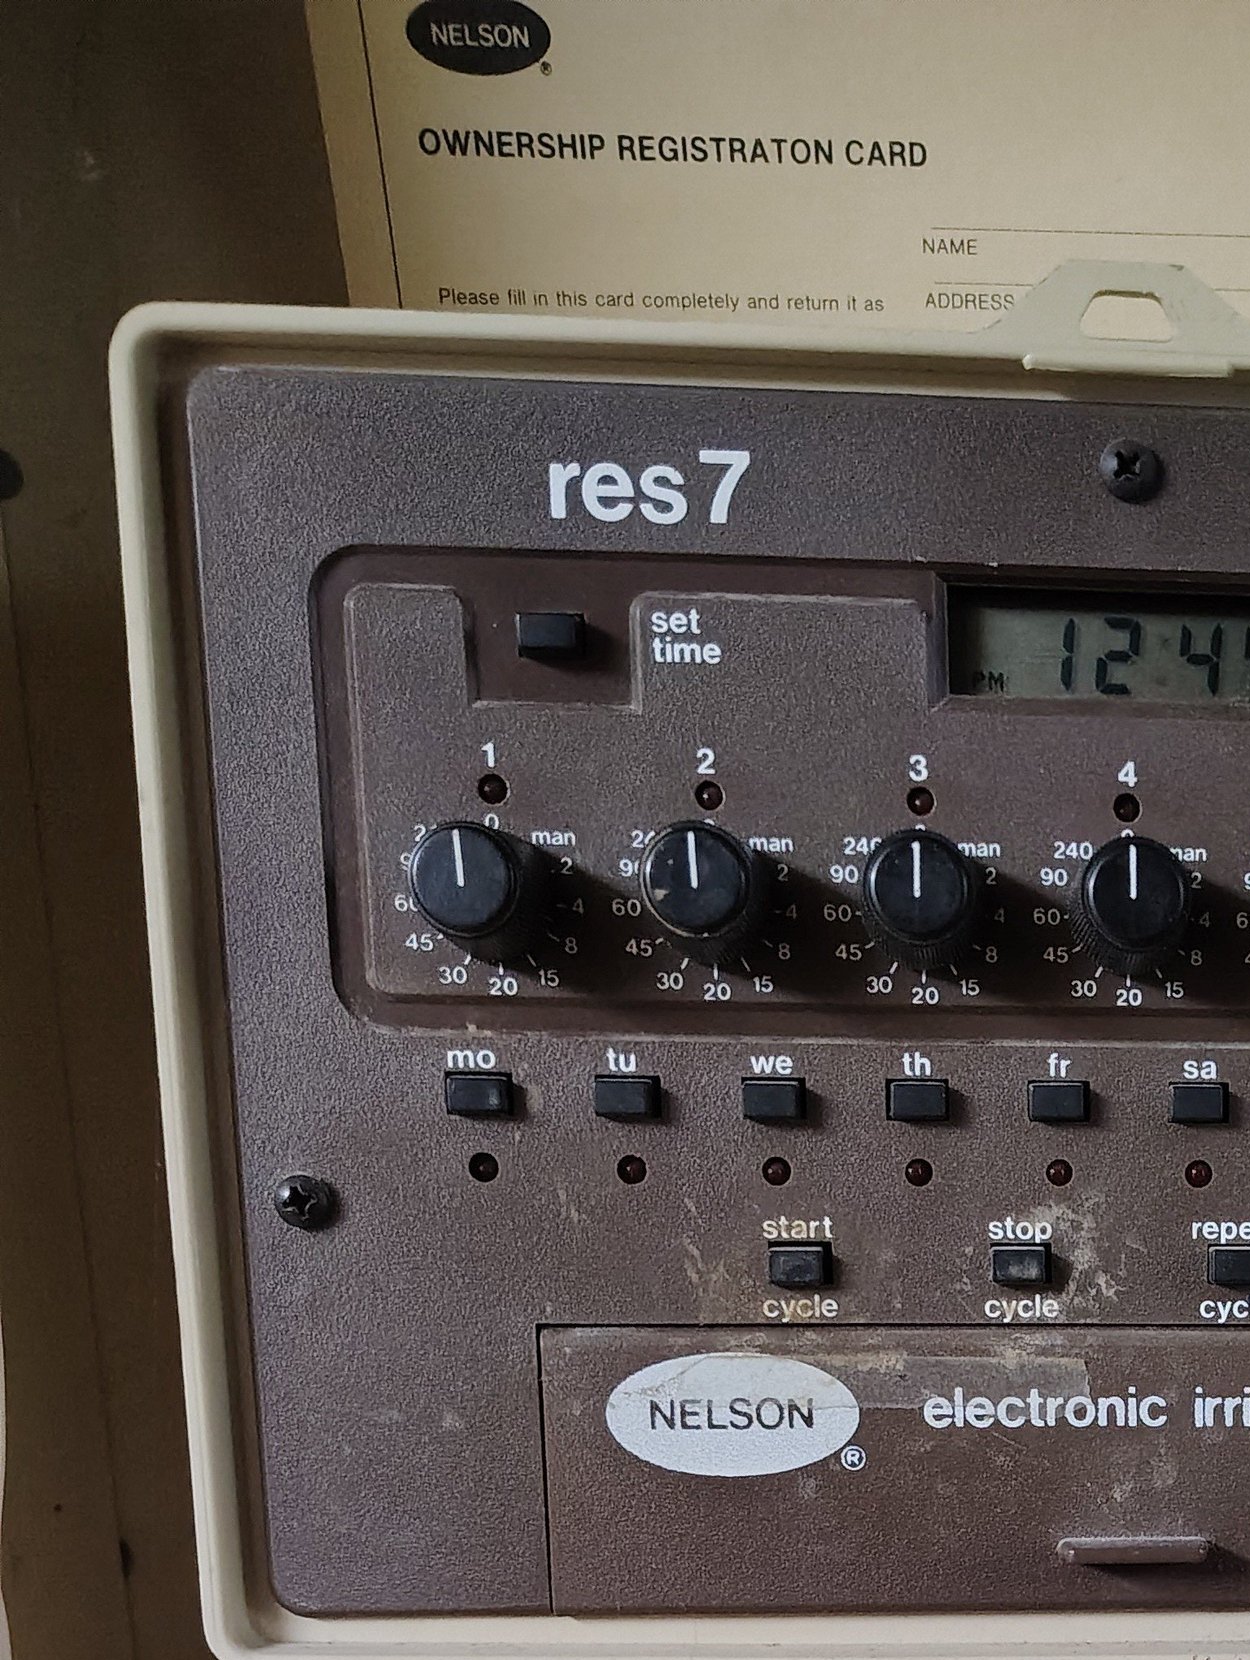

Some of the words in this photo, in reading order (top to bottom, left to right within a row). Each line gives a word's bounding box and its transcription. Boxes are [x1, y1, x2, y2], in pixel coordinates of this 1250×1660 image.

[431, 23, 529, 48] NELSON
[418, 128, 605, 159] OWNERSHIP
[617, 135, 833, 164] REGISTRATON
[846, 140, 926, 166] CARD
[923, 239, 977, 255] NAME
[439, 287, 499, 305] Please
[508, 289, 526, 305] fill
[534, 294, 548, 306] in
[556, 291, 587, 306] this
[596, 292, 634, 307] card
[642, 293, 739, 312] completely
[748, 294, 779, 309] and
[788, 296, 838, 310] return
[848, 296, 856, 311] it
[864, 299, 884, 311] as
[925, 293, 1014, 311] ADDRESS
[652, 609, 702, 635] set
[653, 636, 721, 666] time
[482, 742, 495, 767] 1
[697, 748, 715, 774] 2
[909, 755, 928, 781] 3
[1118, 761, 1137, 787] 4
[532, 831, 575, 847] man
[489, 977, 517, 998] 20
[1117, 989, 1142, 1006] 20
[447, 1050, 495, 1068] mo
[606, 1048, 638, 1072] tu
[750, 1056, 793, 1074] we
[902, 1052, 932, 1076] th
[1047, 1053, 1070, 1077] fr
[1183, 1061, 1216, 1079] sa
[762, 1216, 833, 1239] start
[988, 1217, 1052, 1243] stop
[762, 1296, 839, 1321] cycle
[984, 1296, 1059, 1322] cycle
[650, 1398, 814, 1430] NELSON
[922, 1385, 1168, 1431] electronic
